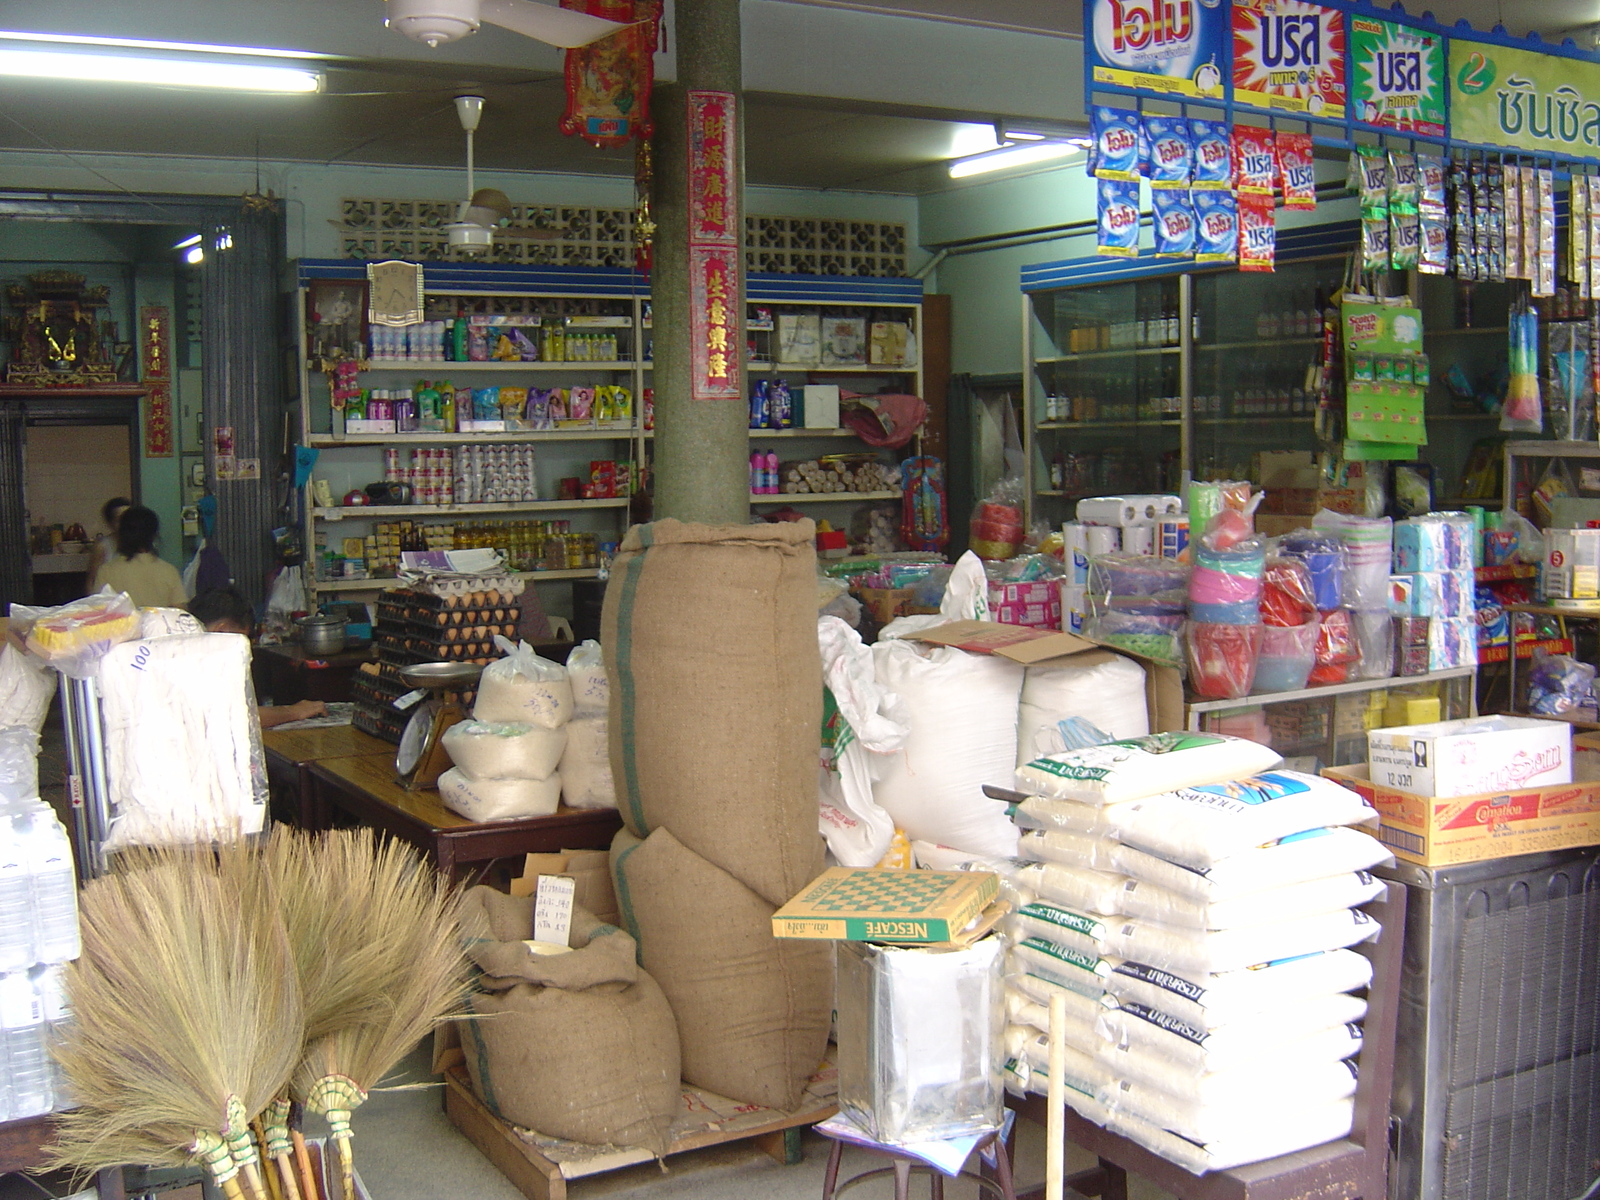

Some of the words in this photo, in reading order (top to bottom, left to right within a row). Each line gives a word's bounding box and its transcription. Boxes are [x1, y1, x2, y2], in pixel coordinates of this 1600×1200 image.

[1107, 0, 1192, 52] โอโม
[1260, 14, 1320, 68] บรีส
[1376, 51, 1422, 93] บรีส
[1463, 51, 1487, 88] 2
[703, 115, 726, 226] 財源廣進
[706, 268, 728, 379] 生意興隆
[1348, 313, 1376, 326] Scotch
[1355, 322, 1376, 334] Brite
[1387, 771, 1396, 786] 12
[865, 920, 929, 939] NESCAFÉ
